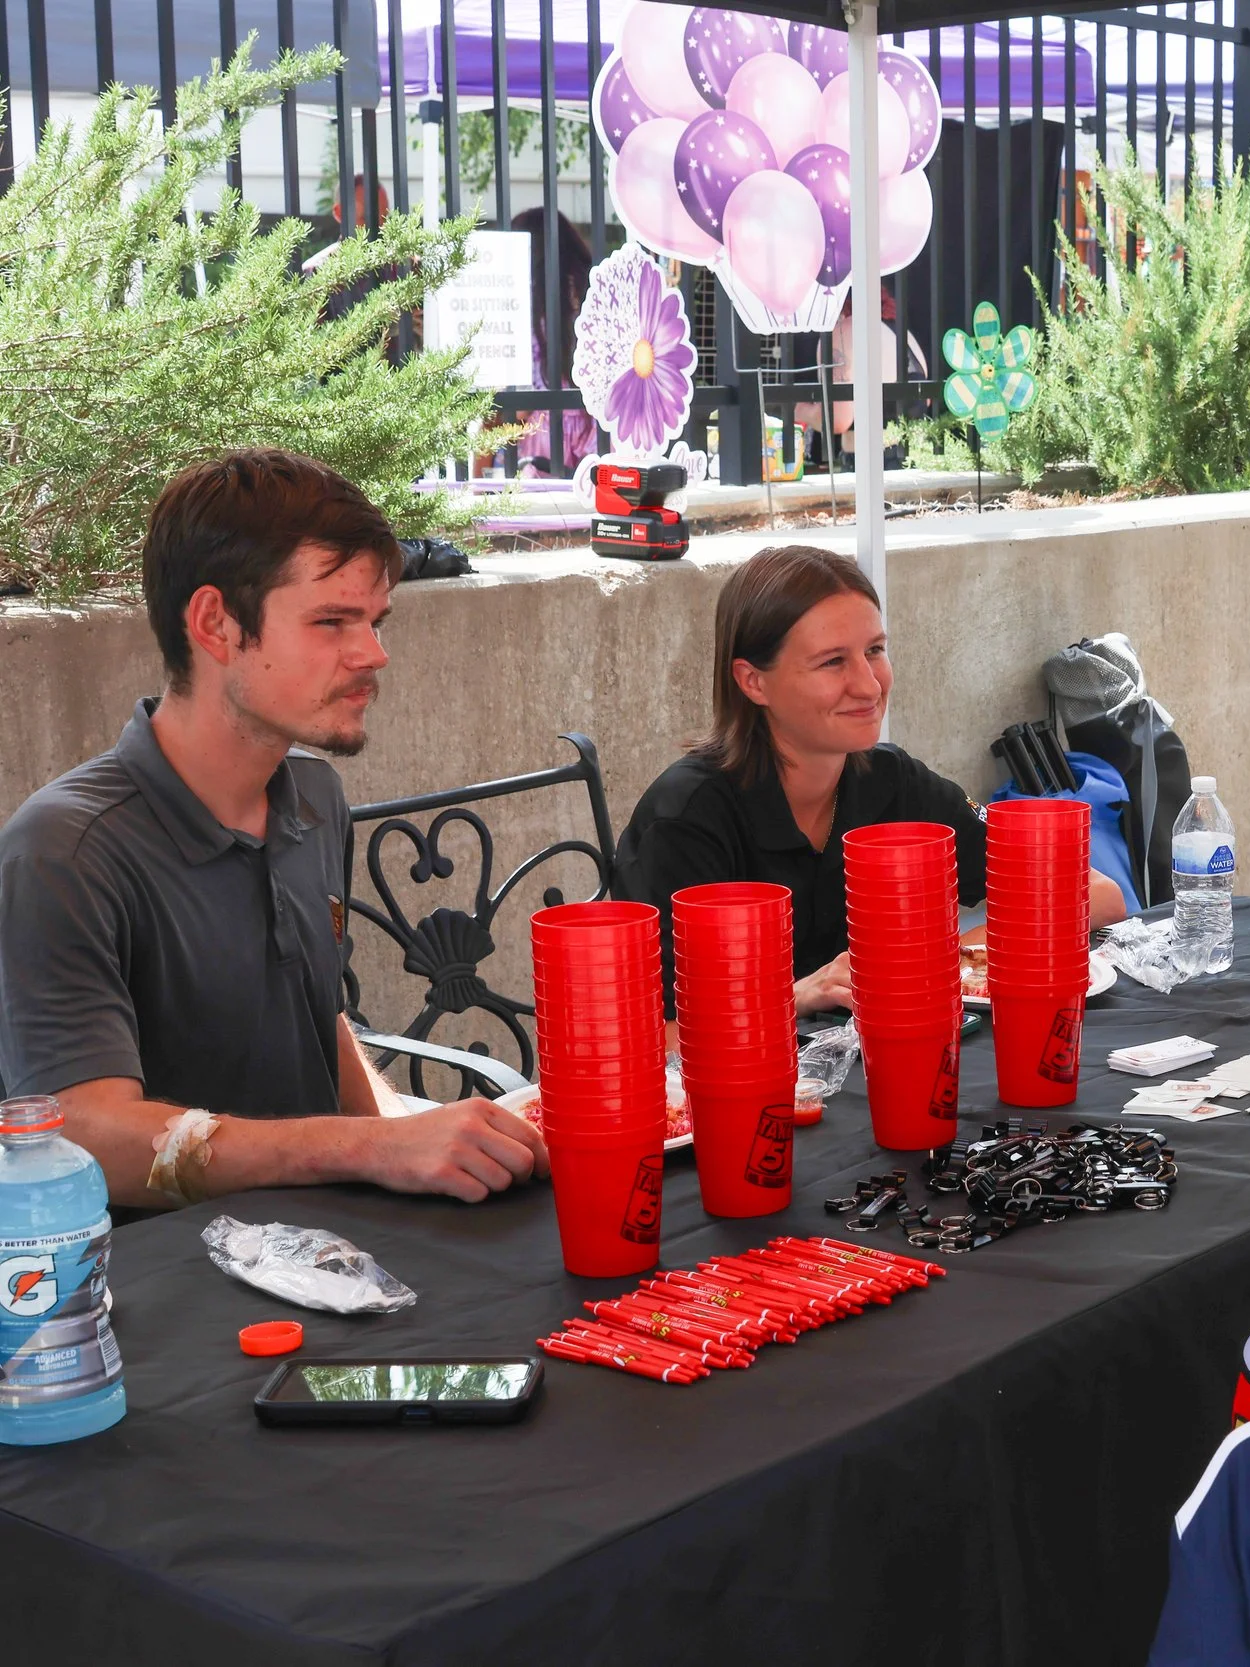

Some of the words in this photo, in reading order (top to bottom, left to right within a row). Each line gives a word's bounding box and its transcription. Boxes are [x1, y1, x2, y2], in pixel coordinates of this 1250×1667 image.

[452, 274, 514, 287] CLIMBING
[450, 298, 469, 311] OR
[472, 298, 520, 311] SITTING
[482, 321, 514, 334] WALL
[478, 345, 516, 358] FENCE
[611, 473, 634, 483] Bauer
[1210, 860, 1233, 869] WATER
[757, 1117, 792, 1142] TAK
[758, 1141, 786, 1174] 5
[40, 1237, 64, 1246] THAN
[66, 1231, 91, 1242] WATER
[0, 1252, 59, 1317] G
[35, 1349, 77, 1364] ADVANCED
